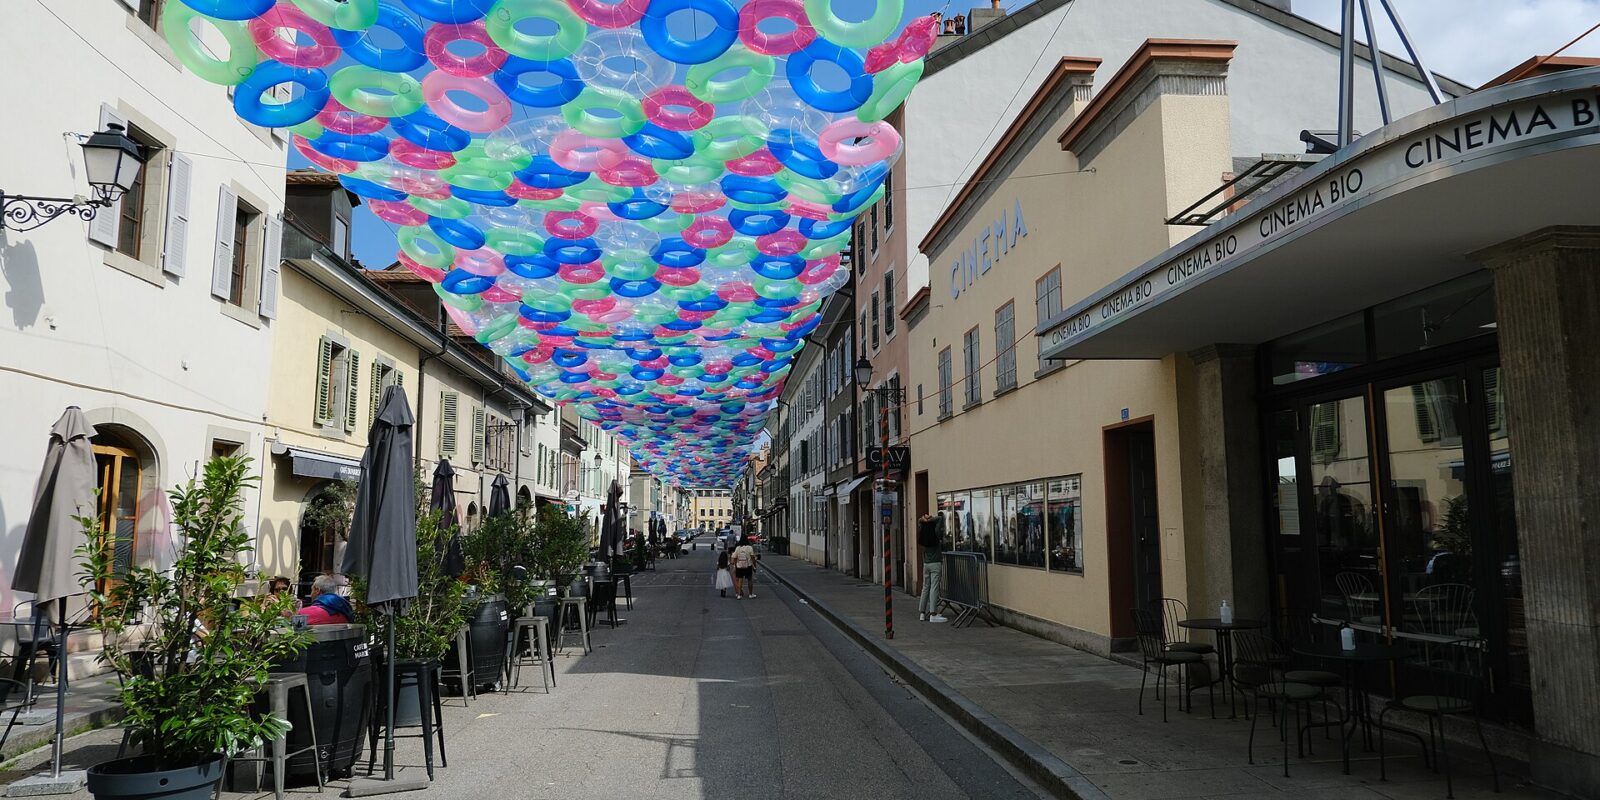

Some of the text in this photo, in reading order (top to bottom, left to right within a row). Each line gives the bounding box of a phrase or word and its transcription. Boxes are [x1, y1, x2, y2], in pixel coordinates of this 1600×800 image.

[1405, 104, 1557, 169] CINEMA
[1259, 168, 1363, 238] CINEMA BIO
[950, 198, 1028, 300] CINEMA
[1167, 235, 1237, 285] CINEMA BIO
[1101, 280, 1152, 319] CINEMA BIO
[1052, 313, 1091, 345] CINEMA BIO
